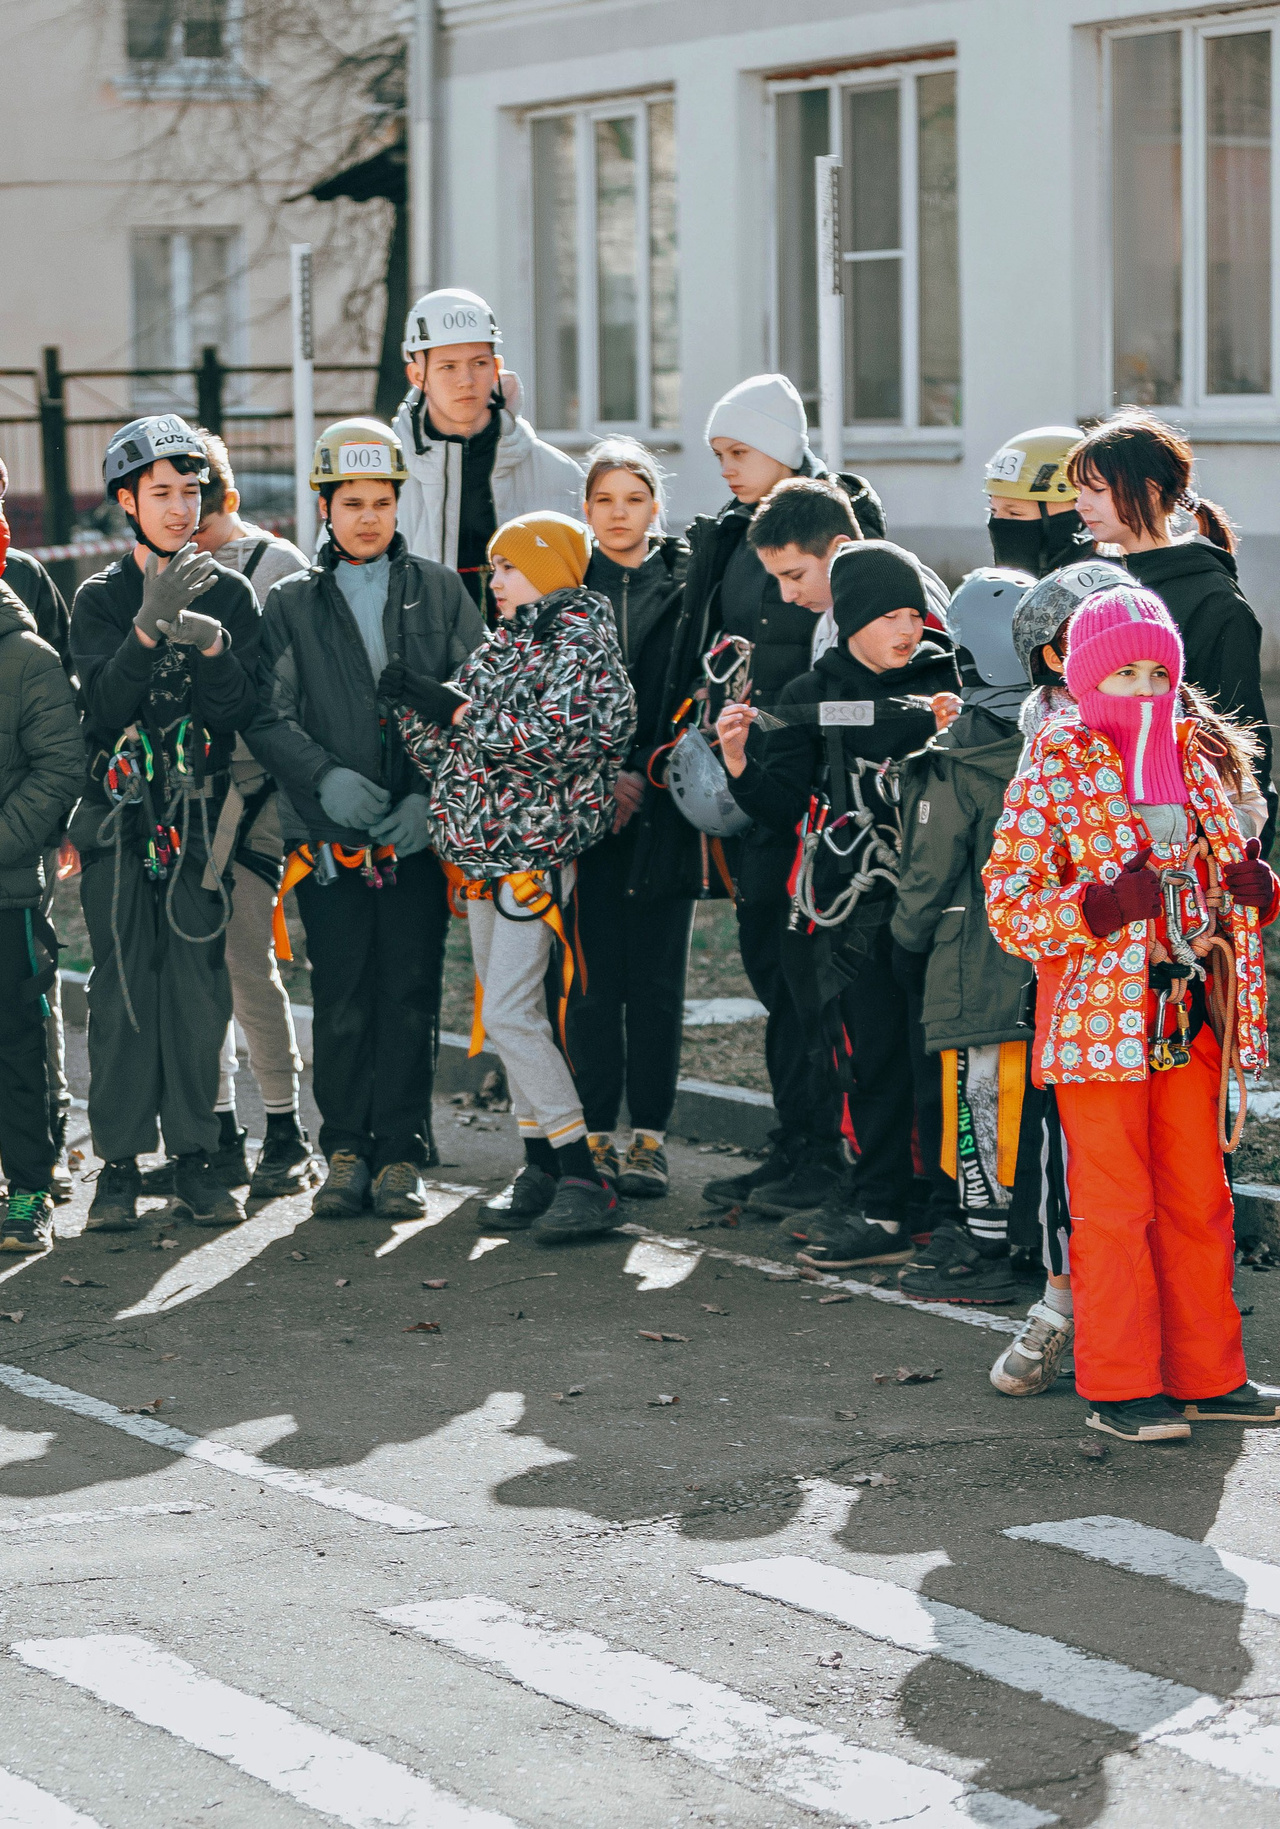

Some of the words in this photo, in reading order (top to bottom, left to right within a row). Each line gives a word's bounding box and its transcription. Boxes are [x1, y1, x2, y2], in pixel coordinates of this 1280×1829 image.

[443, 310, 478, 329] 008
[157, 418, 181, 433] 00
[346, 449, 382, 468] 003
[996, 456, 1018, 475] 43
[1078, 568, 1111, 588] 02
[959, 1134, 976, 1156] IS
[962, 1159, 990, 1209] WHAT
